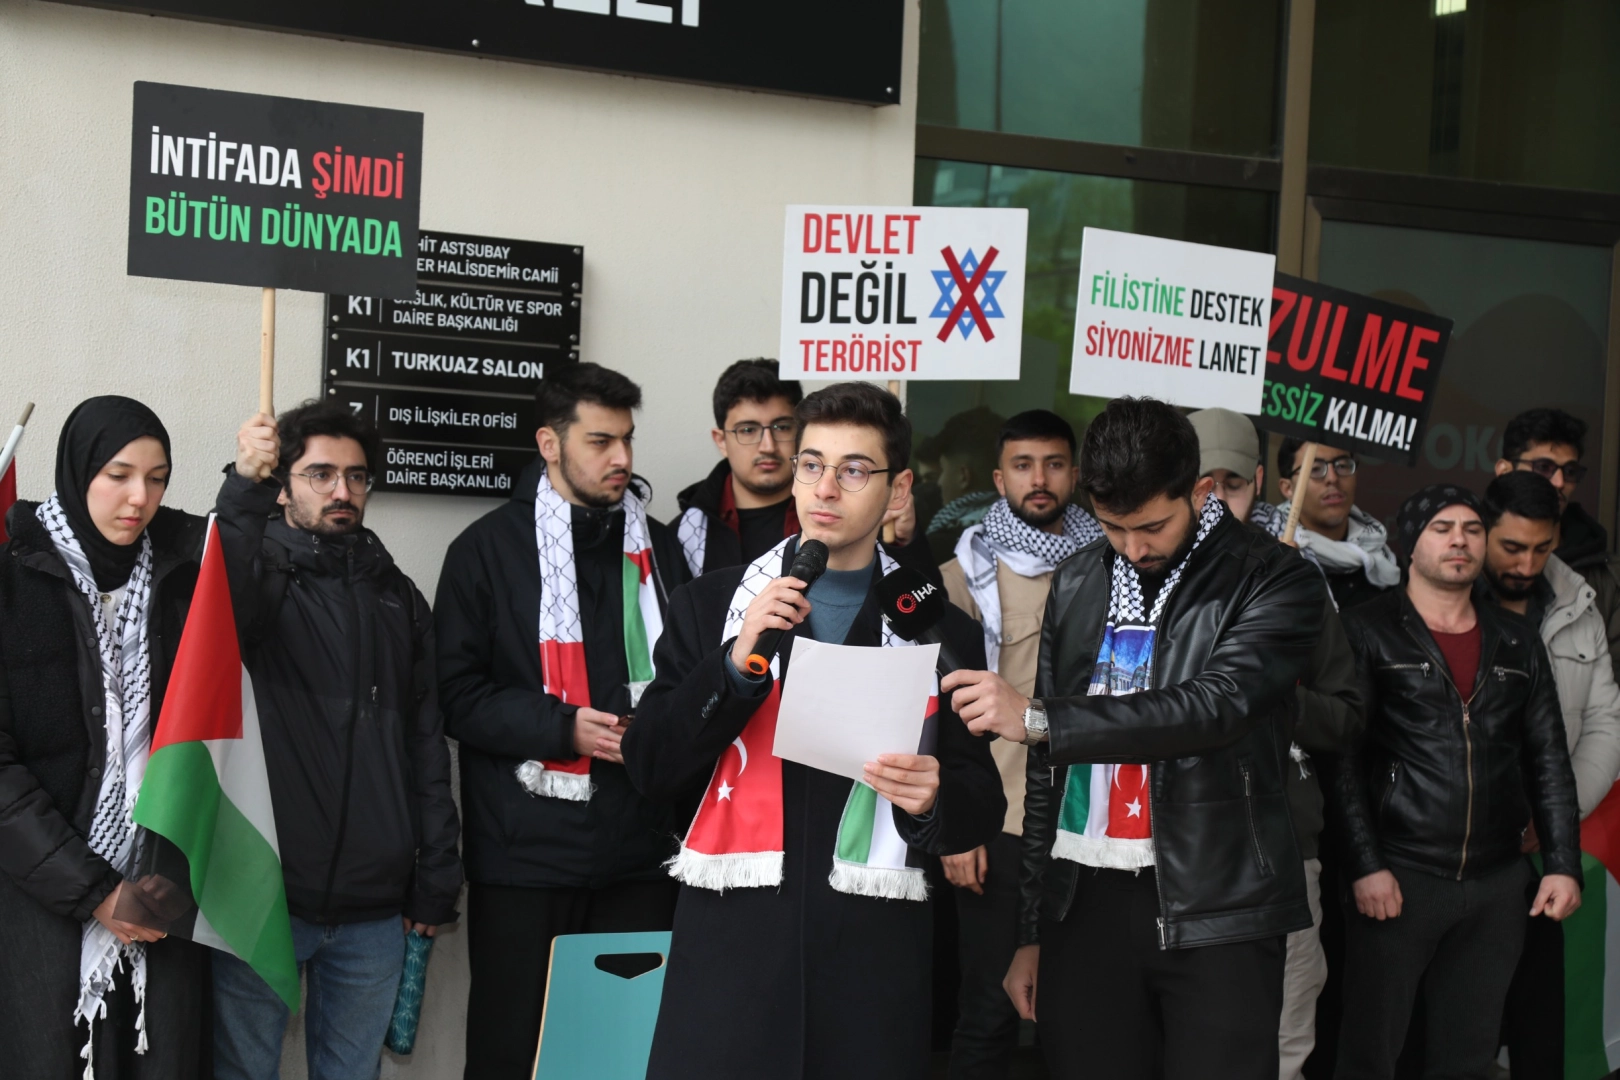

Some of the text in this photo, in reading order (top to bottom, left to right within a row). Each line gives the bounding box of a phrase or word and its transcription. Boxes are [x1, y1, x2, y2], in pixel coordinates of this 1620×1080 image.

[151, 125, 404, 199] İNTİFADA ŞİMDİ
[145, 191, 402, 258] BÜTÜN DÜNYADA
[802, 212, 921, 255] DEVLET
[440, 240, 510, 260] ASTSUBAY
[416, 258, 560, 283] ER HALİSDEMİR CAMİİ
[348, 295, 372, 316] K1
[450, 293, 503, 312] KÜLTÜR
[506, 300, 524, 314] VE
[526, 301, 562, 317] SPOR
[800, 260, 917, 325] DEĞİL
[1091, 270, 1265, 327] FİLİSTİNE DESTEK
[393, 308, 518, 333] DAİRE BAŞKANLIĞI
[346, 348, 370, 369] K1
[799, 333, 922, 372] TERÖRİST
[1085, 321, 1261, 376] SİYONİZME LANET
[1266, 287, 1441, 402] ZULME
[392, 351, 544, 380] TURKUAZ SALON
[389, 406, 517, 429] DIŞ İLİŞKİLER OFİSİ
[1324, 396, 1418, 451] KALMA!
[386, 447, 494, 470] ÖĞRENCİ İŞLERİ
[1425, 422, 1503, 473] OK
[386, 468, 511, 490] DAİRE BAŞKANLIĞI
[911, 583, 938, 603] İHA
